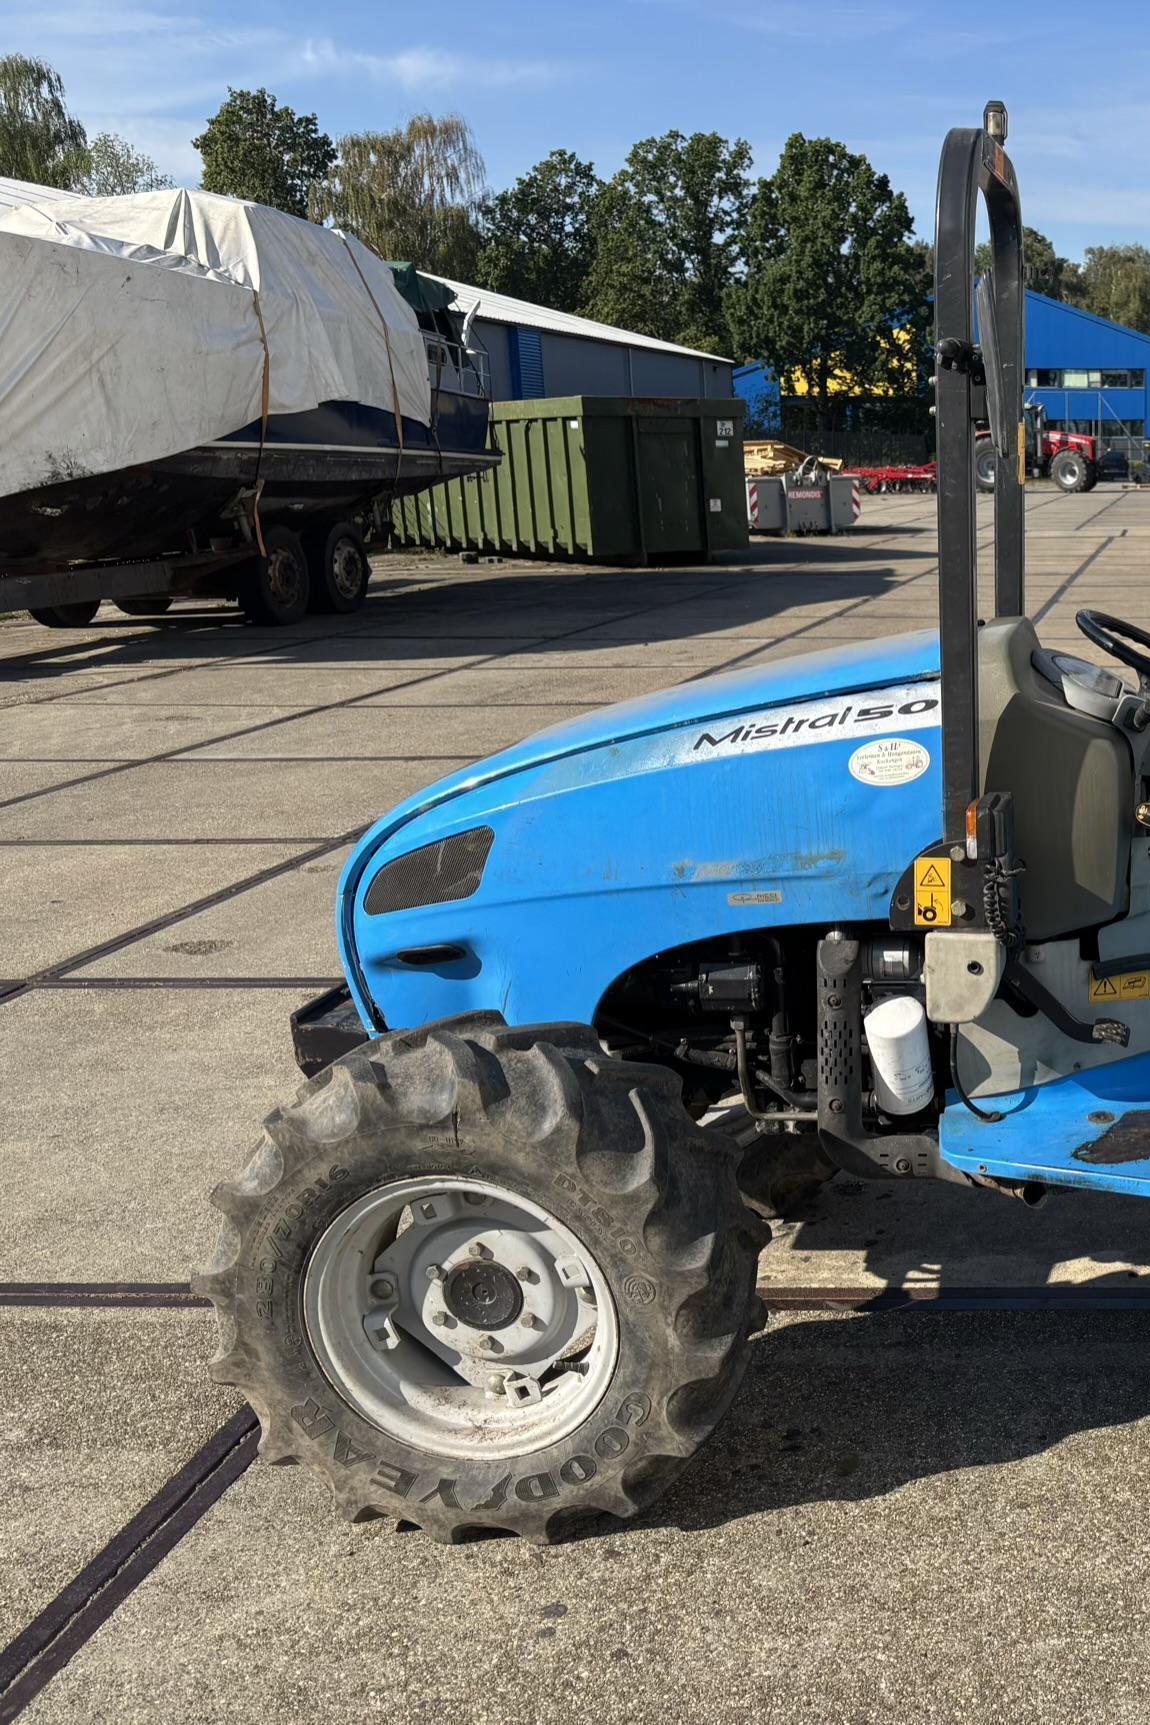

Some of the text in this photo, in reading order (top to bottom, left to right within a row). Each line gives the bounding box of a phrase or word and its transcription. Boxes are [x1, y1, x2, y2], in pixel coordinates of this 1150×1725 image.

[693, 698, 940, 751] Mistral 50
[256, 1164, 350, 1321] 280/70R16
[290, 1391, 652, 1511] GOODYEAR
